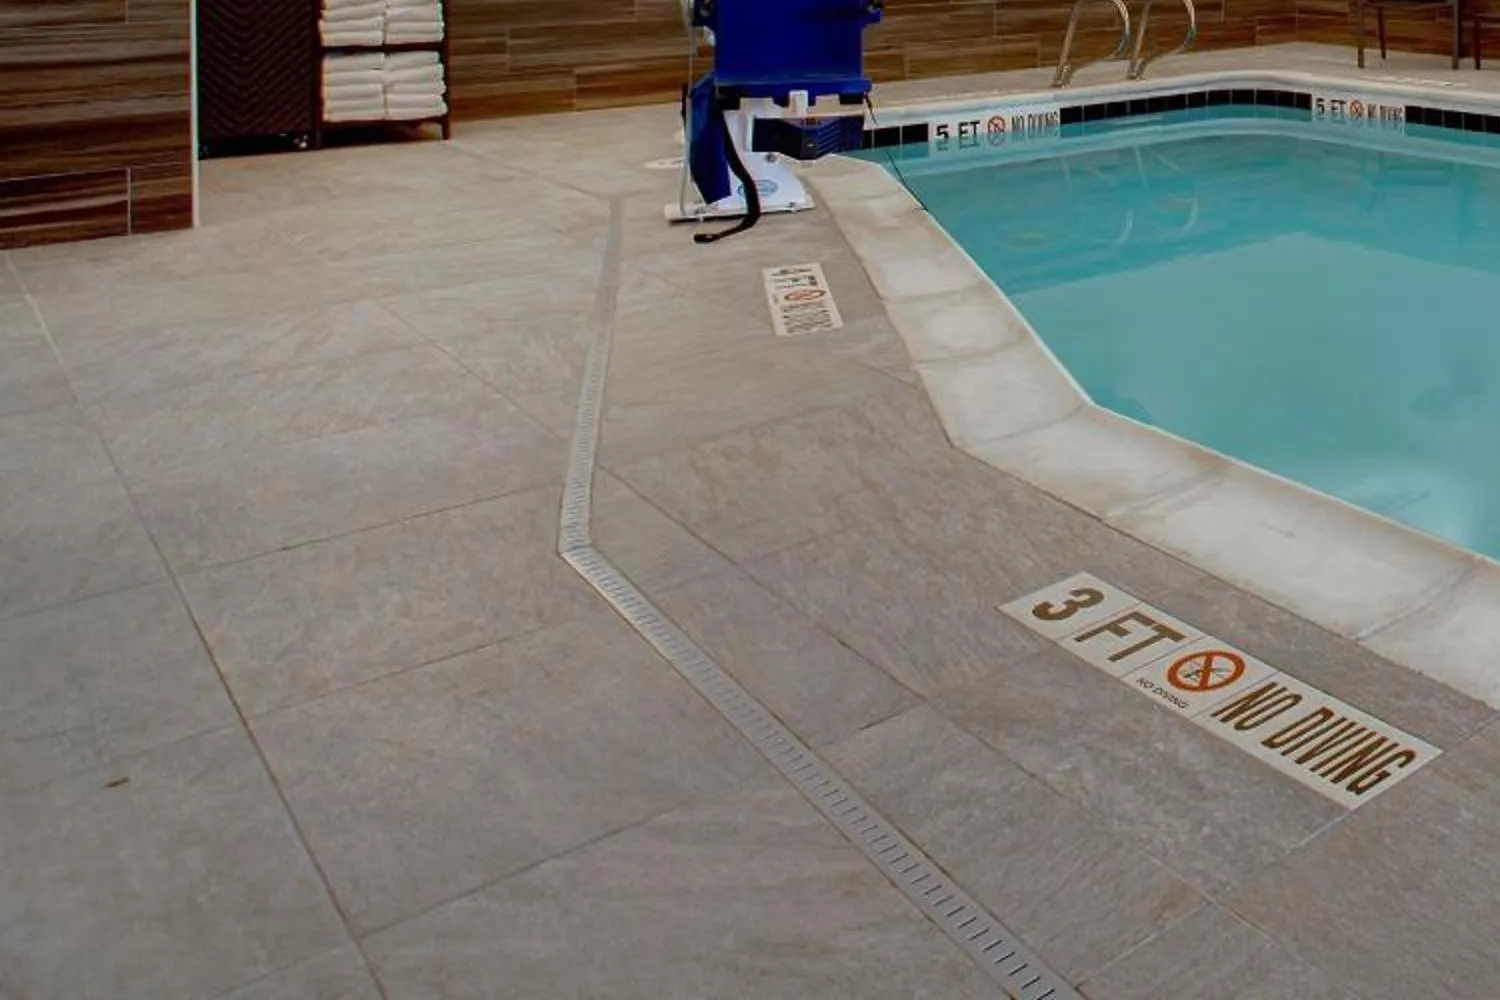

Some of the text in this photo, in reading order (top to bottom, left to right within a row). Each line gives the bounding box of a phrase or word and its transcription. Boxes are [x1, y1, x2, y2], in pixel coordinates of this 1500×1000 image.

[1031, 587, 1418, 796] 3 FT NO DIVING
